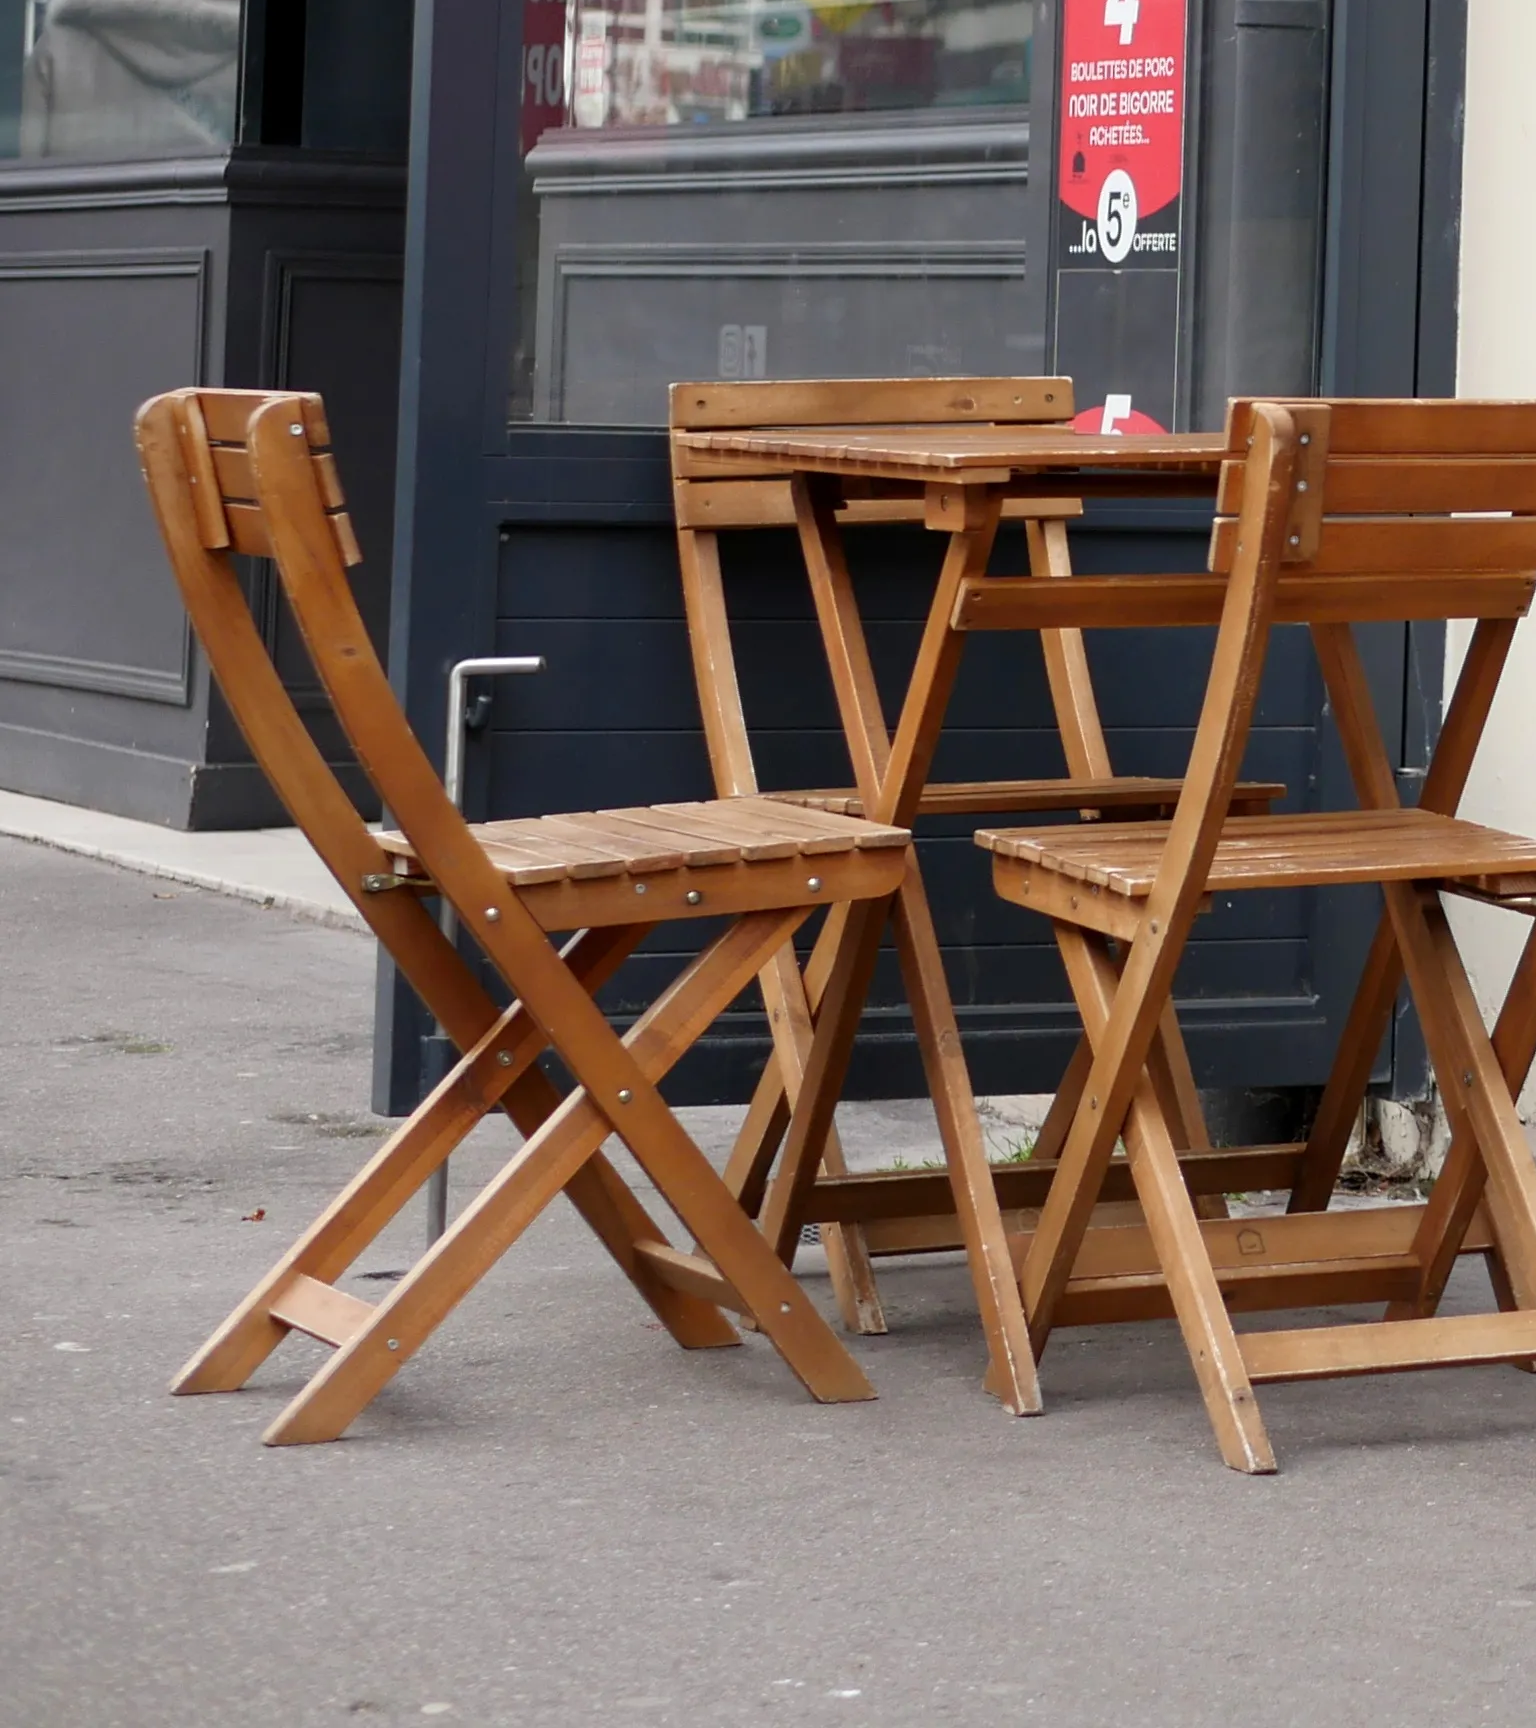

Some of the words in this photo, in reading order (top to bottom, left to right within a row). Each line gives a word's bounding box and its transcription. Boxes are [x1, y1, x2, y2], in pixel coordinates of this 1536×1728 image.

[1070, 59, 1128, 82] BOULETTES
[1128, 58, 1143, 79] DE
[1144, 56, 1175, 78] PORC
[1100, 92, 1117, 116] DE
[1119, 90, 1175, 116] BIGORRE
[1133, 232, 1176, 252] OFFERTE
